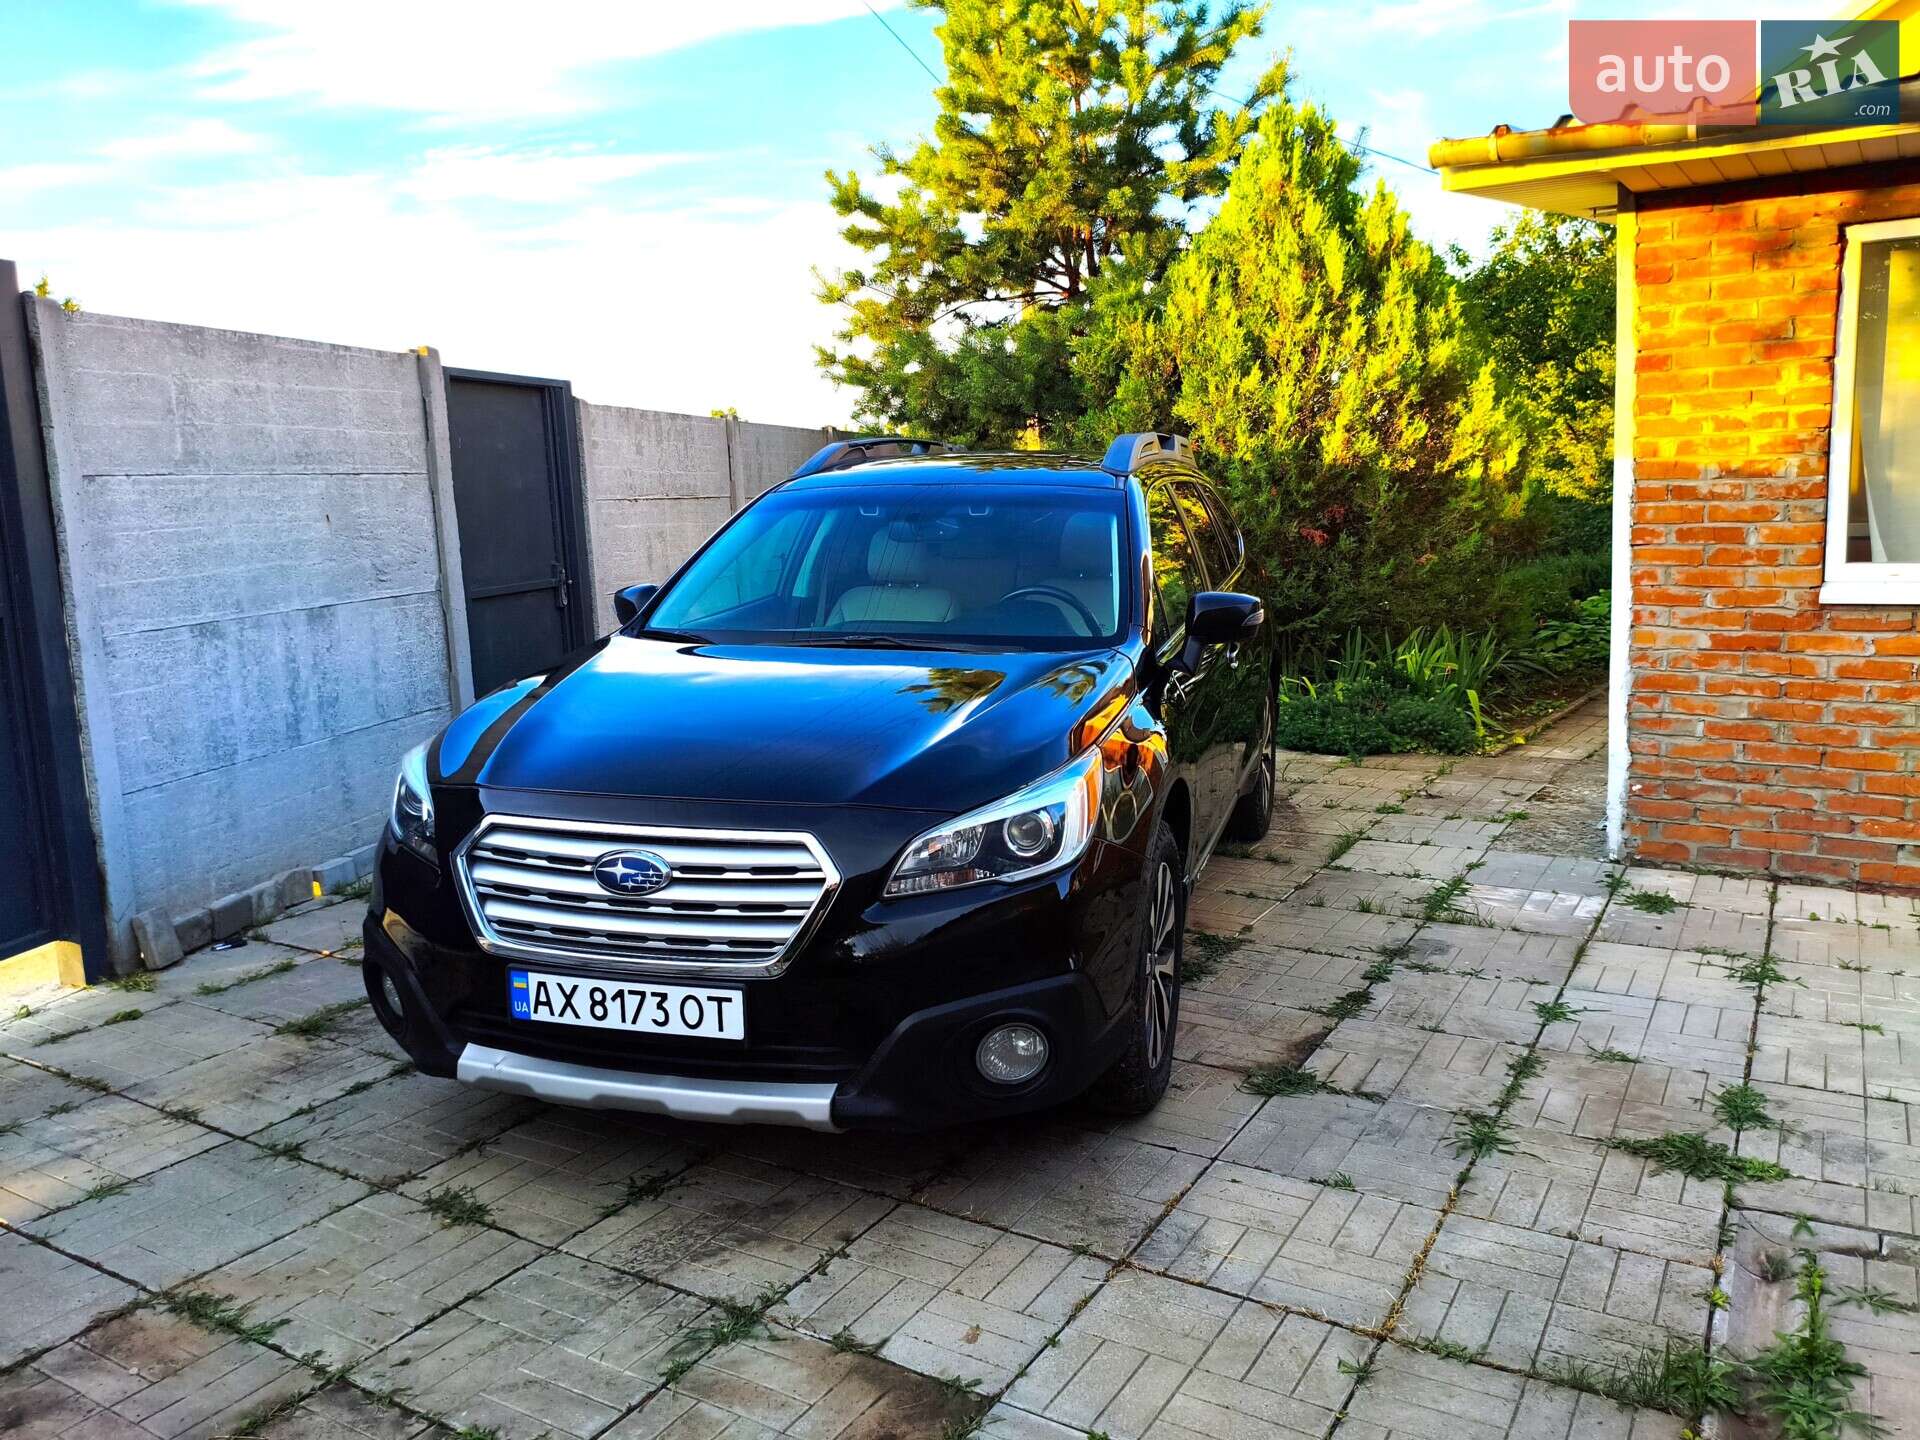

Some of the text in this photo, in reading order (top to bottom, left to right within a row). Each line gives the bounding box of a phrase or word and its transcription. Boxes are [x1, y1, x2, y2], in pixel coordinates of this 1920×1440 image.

[514, 1000, 529, 1013] UA
[533, 981, 733, 1032] AX 8173 OT
